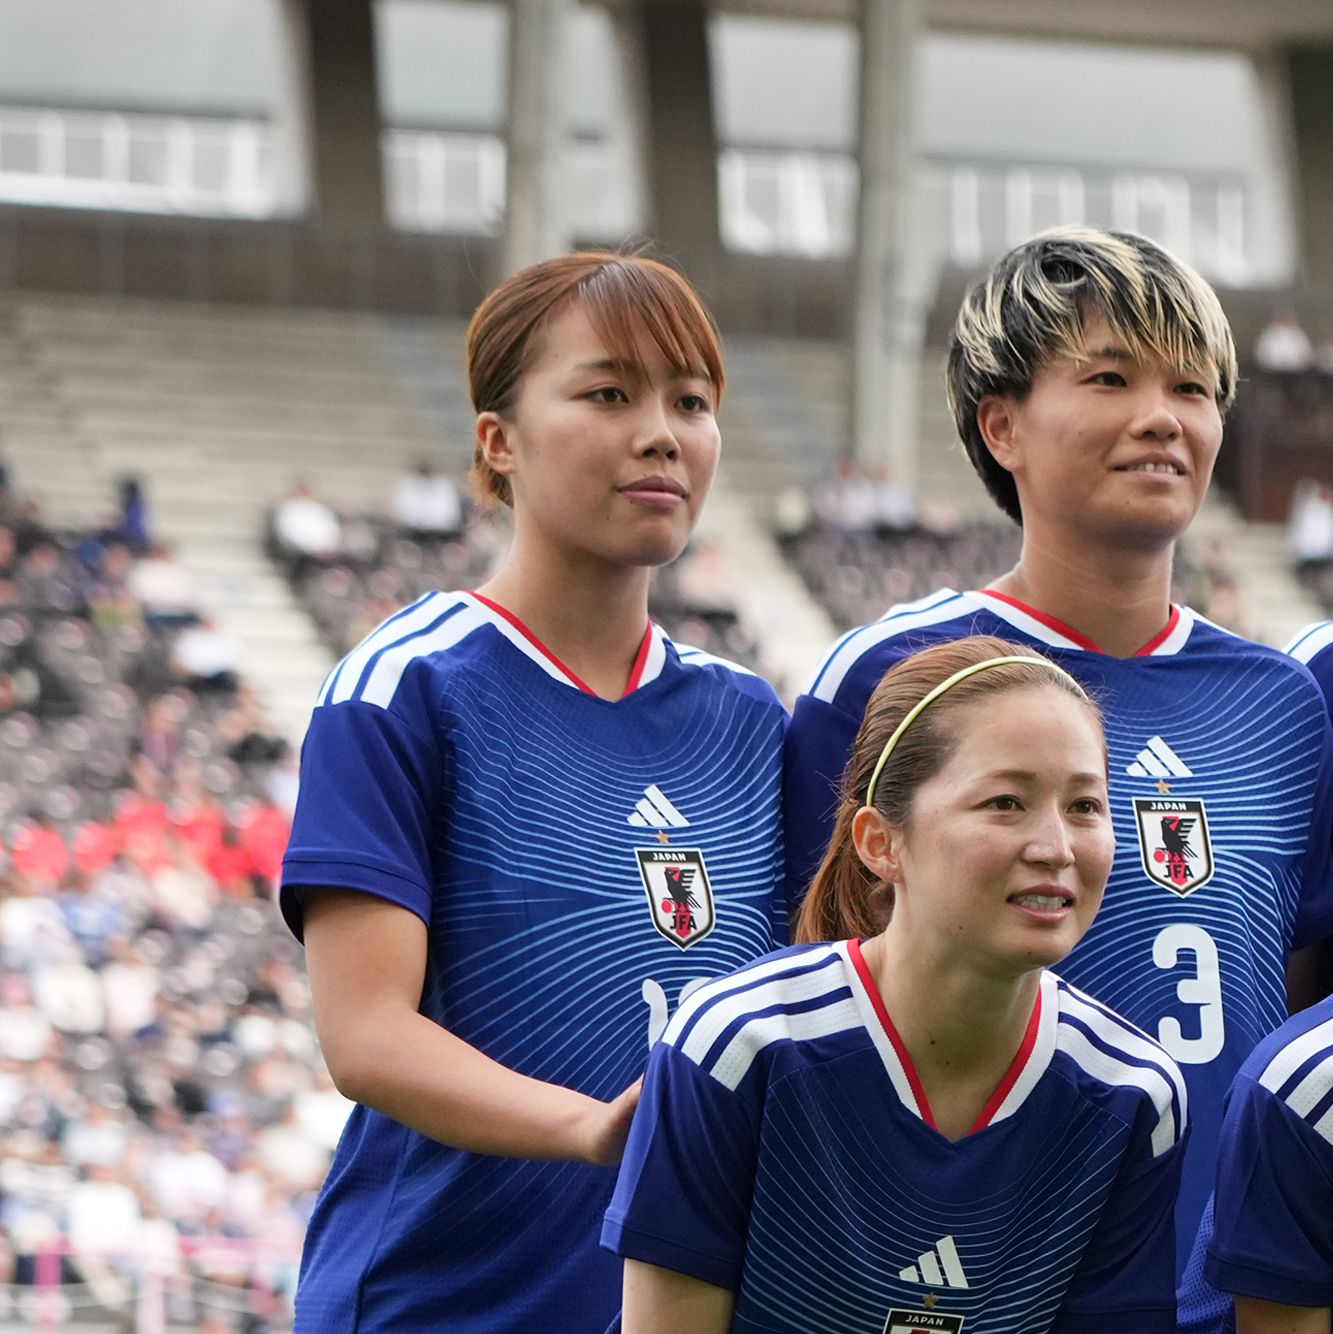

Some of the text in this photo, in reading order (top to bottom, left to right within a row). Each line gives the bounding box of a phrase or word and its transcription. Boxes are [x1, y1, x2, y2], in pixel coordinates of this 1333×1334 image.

[1150, 801, 1187, 811] JAPAN
[652, 852, 687, 862] JAPAN
[1164, 864, 1194, 880] JFA
[670, 915, 697, 931] JFA
[1152, 923, 1225, 1064] 3
[642, 977, 713, 1052] 1
[905, 1315, 944, 1326] JAPAN
